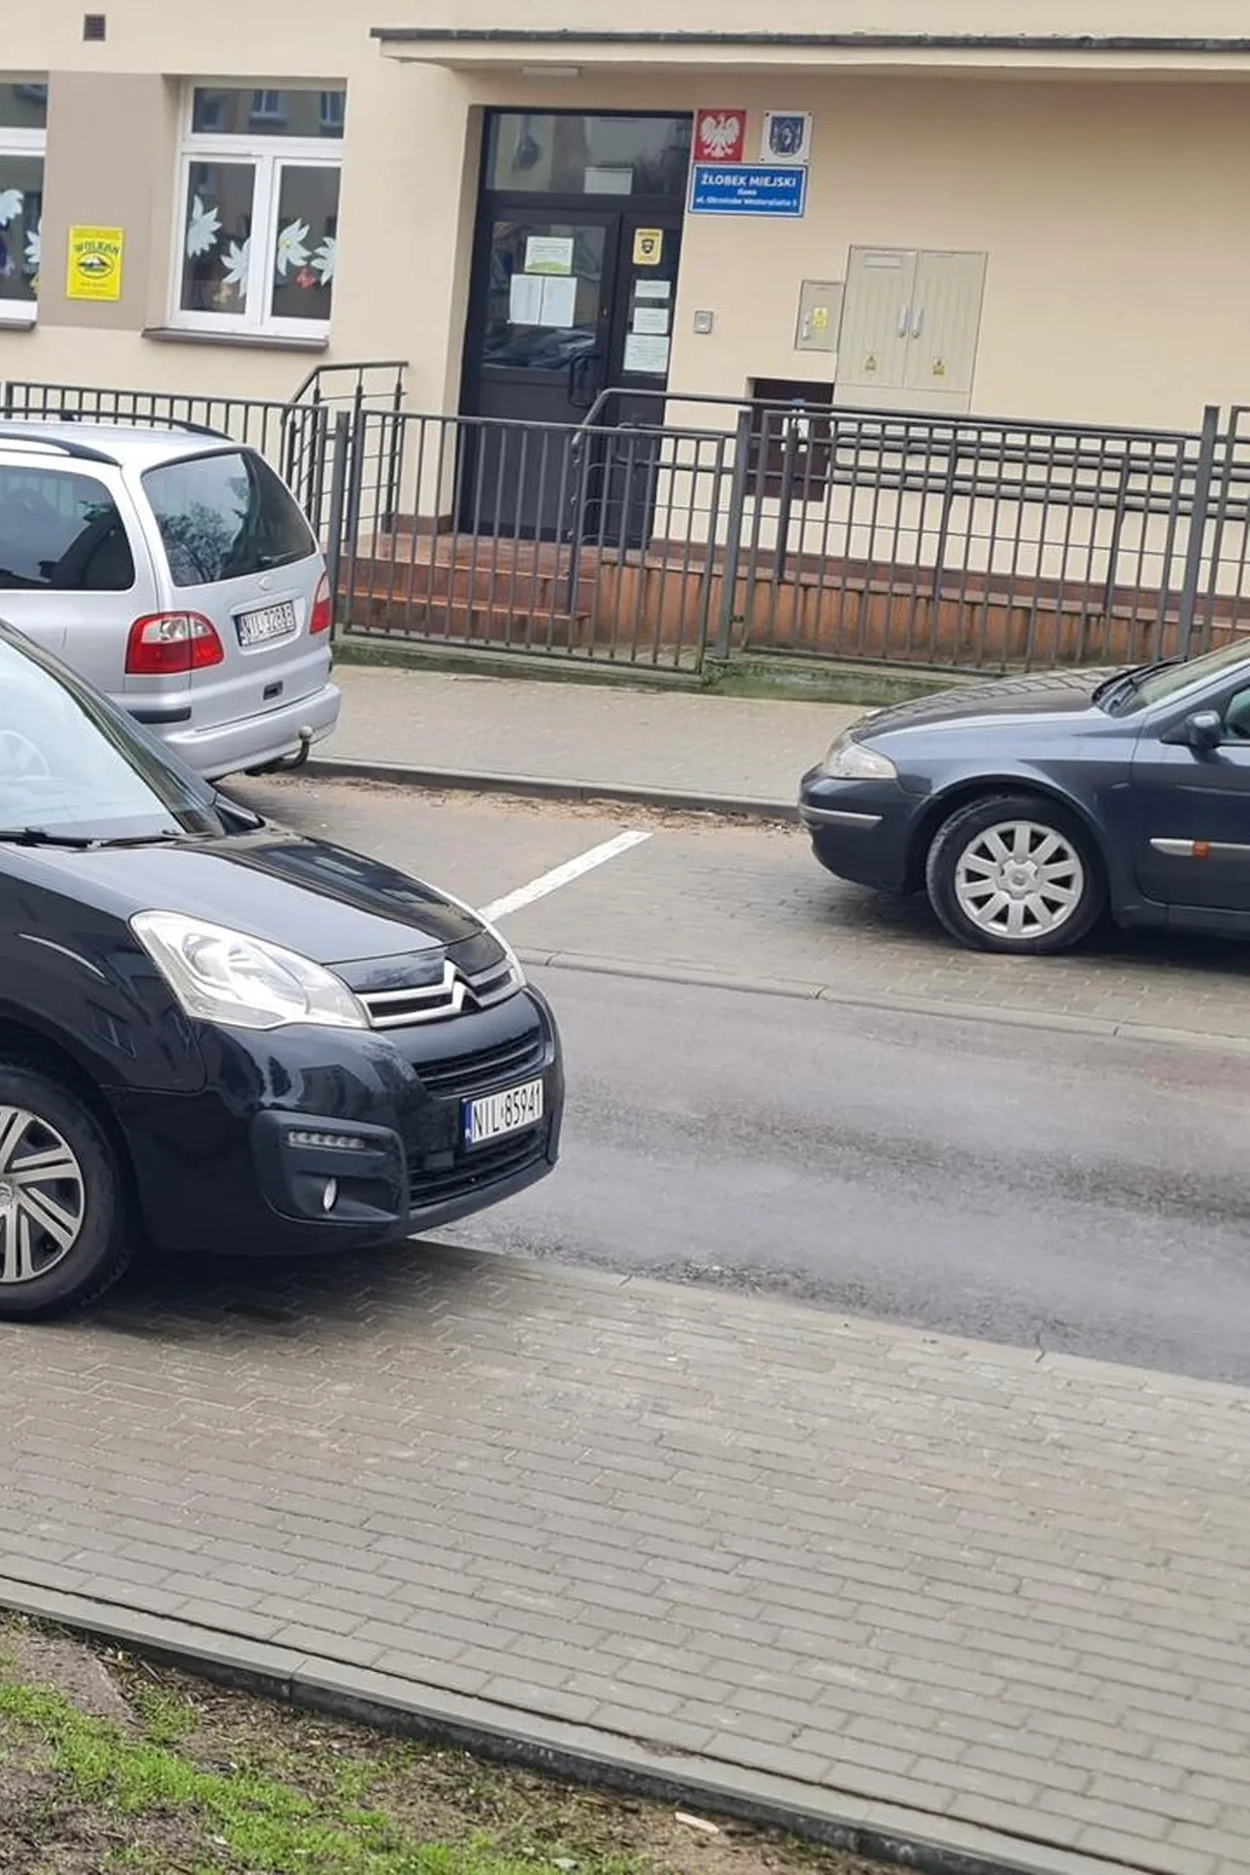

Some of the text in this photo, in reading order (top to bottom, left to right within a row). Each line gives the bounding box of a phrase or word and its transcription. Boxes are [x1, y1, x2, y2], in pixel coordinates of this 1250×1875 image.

[701, 172, 797, 188] ŻŁOBEK MIEJSKI
[473, 1082, 541, 1140] NIL 85941
